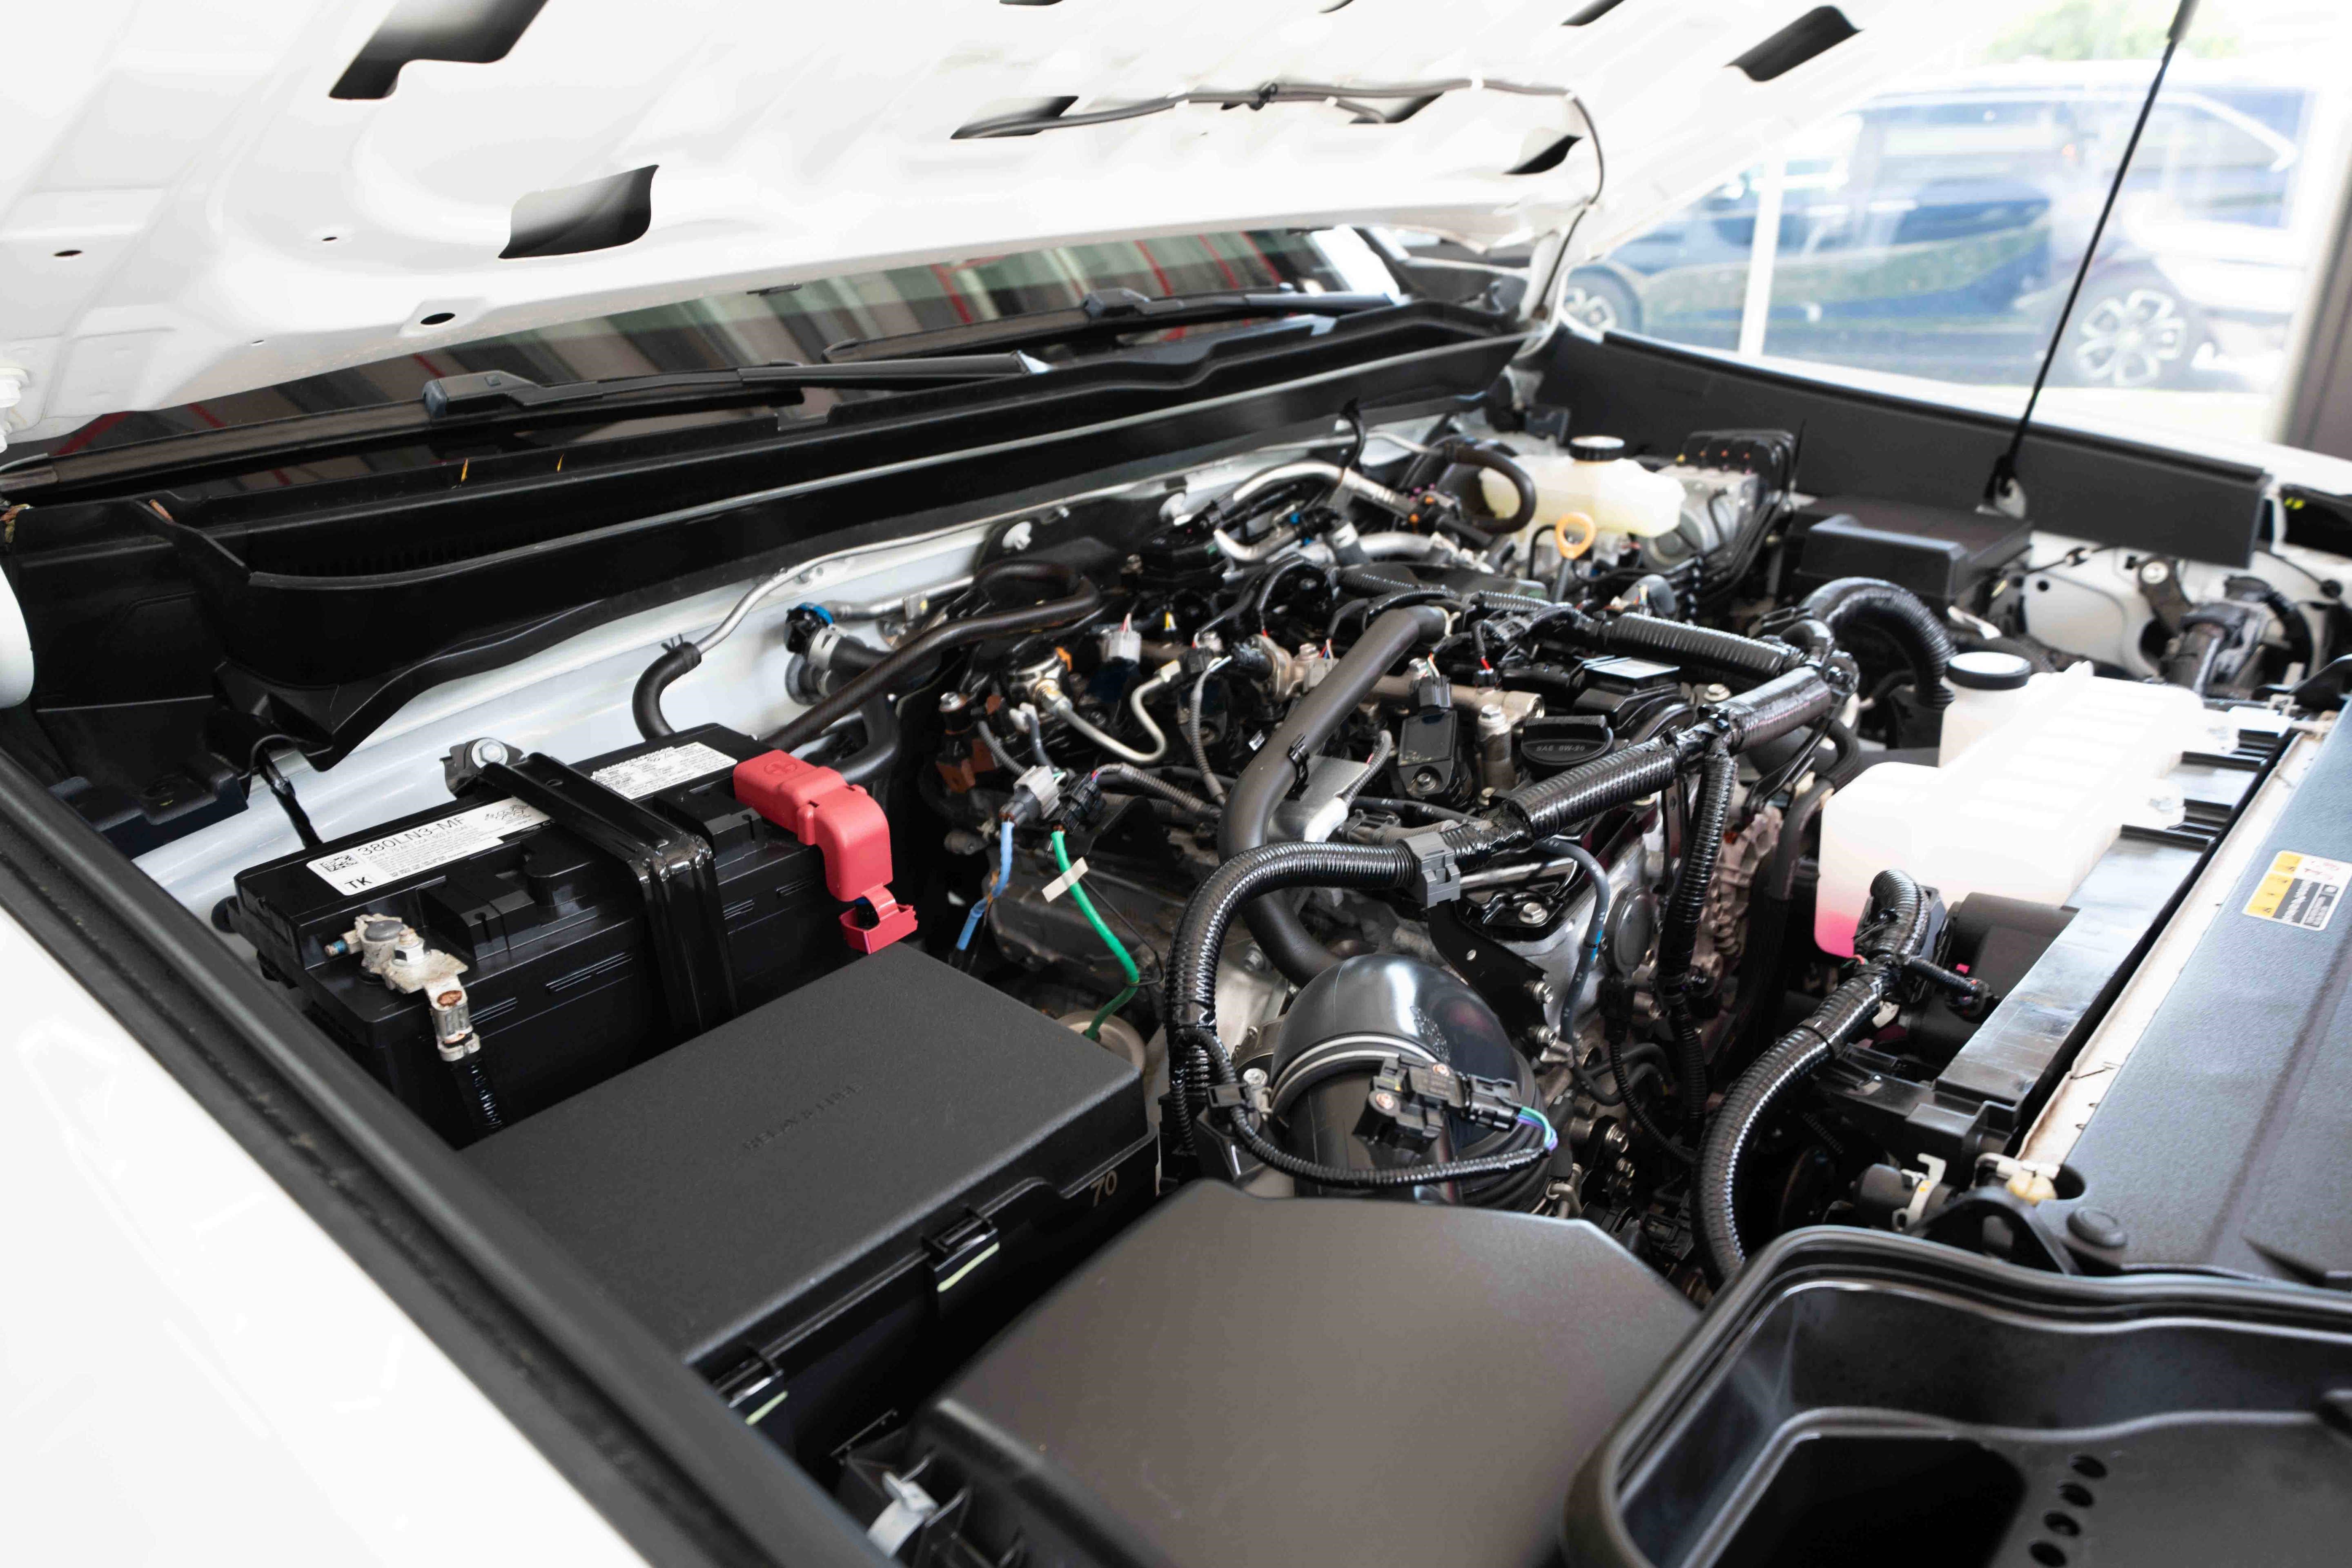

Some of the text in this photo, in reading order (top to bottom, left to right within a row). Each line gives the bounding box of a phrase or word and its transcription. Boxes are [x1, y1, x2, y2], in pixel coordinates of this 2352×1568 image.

[358, 816, 465, 856] 380LN3-MF
[344, 876, 372, 889] TK
[1090, 1169, 1117, 1207] 70
